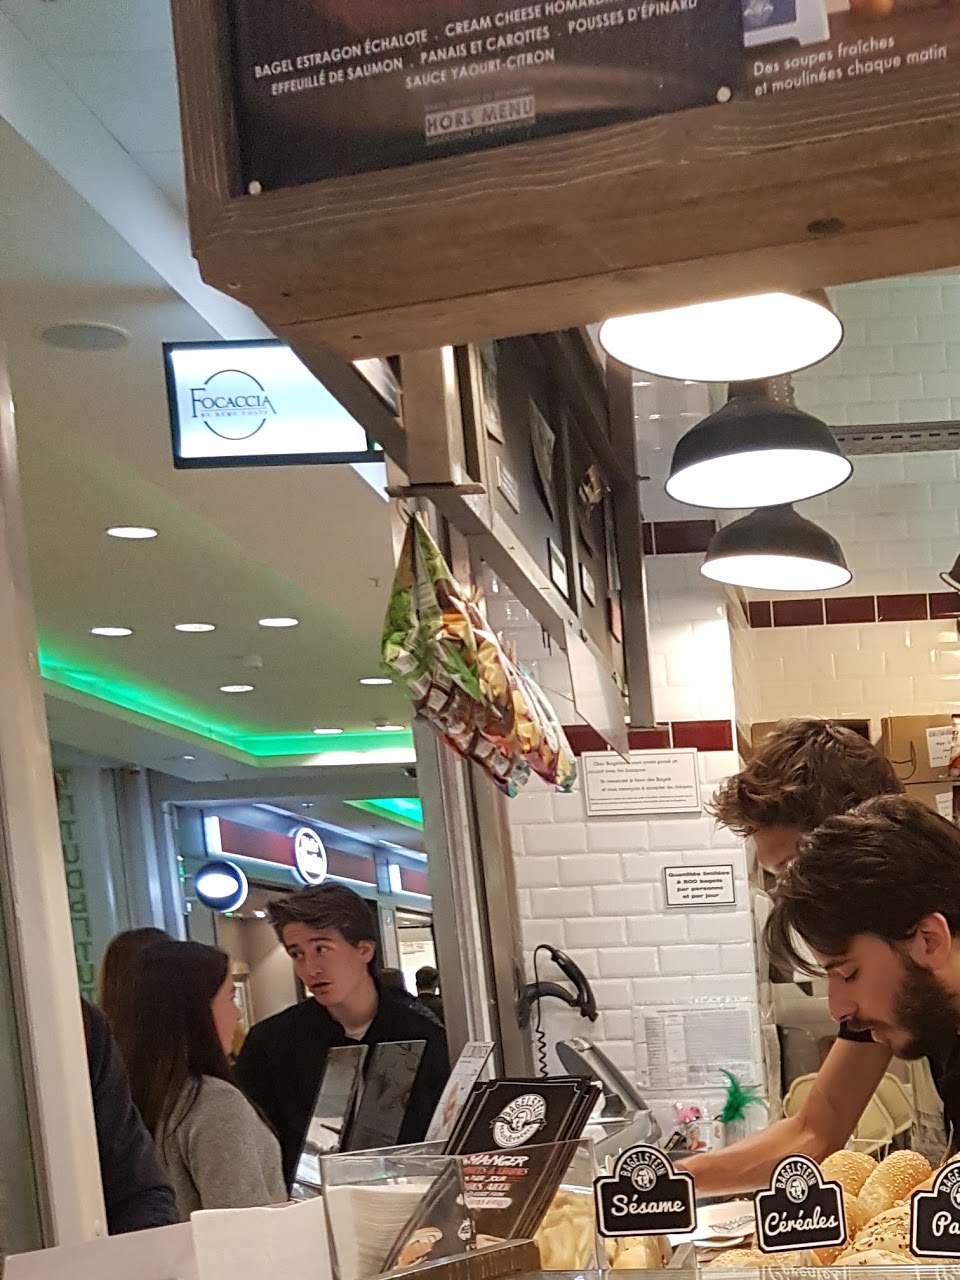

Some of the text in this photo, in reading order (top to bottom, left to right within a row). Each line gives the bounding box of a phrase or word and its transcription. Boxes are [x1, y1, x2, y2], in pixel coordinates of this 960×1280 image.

[254, 60, 293, 79] BAGEL
[296, 44, 362, 69] ESTRAGON
[364, 29, 428, 55] ÉCHALOTE
[445, 16, 492, 37] CREAM
[494, 4, 542, 26] CHEESE
[271, 69, 326, 96] EFFEUILLÉ
[329, 69, 344, 84] DE
[346, 57, 403, 80] SAUMON
[420, 42, 467, 64] PANAIS
[470, 38, 483, 55] ET
[486, 25, 551, 50] CAROTTES
[568, 10, 624, 35] POUSSES
[753, 36, 895, 77] Des soupes fraîches
[405, 48, 556, 90] SAUCE YAOURT-CITRON
[754, 44, 948, 96] et moulinées chaque matin
[426, 110, 475, 135] HORS
[481, 97, 534, 123] MENU
[190, 387, 277, 418] FOCACCIA
[620, 1152, 668, 1177] BAGELSTEIN
[775, 1161, 819, 1189] BAGELSTEIN
[611, 1193, 686, 1217] Sésame
[764, 1206, 840, 1237] Céréales
